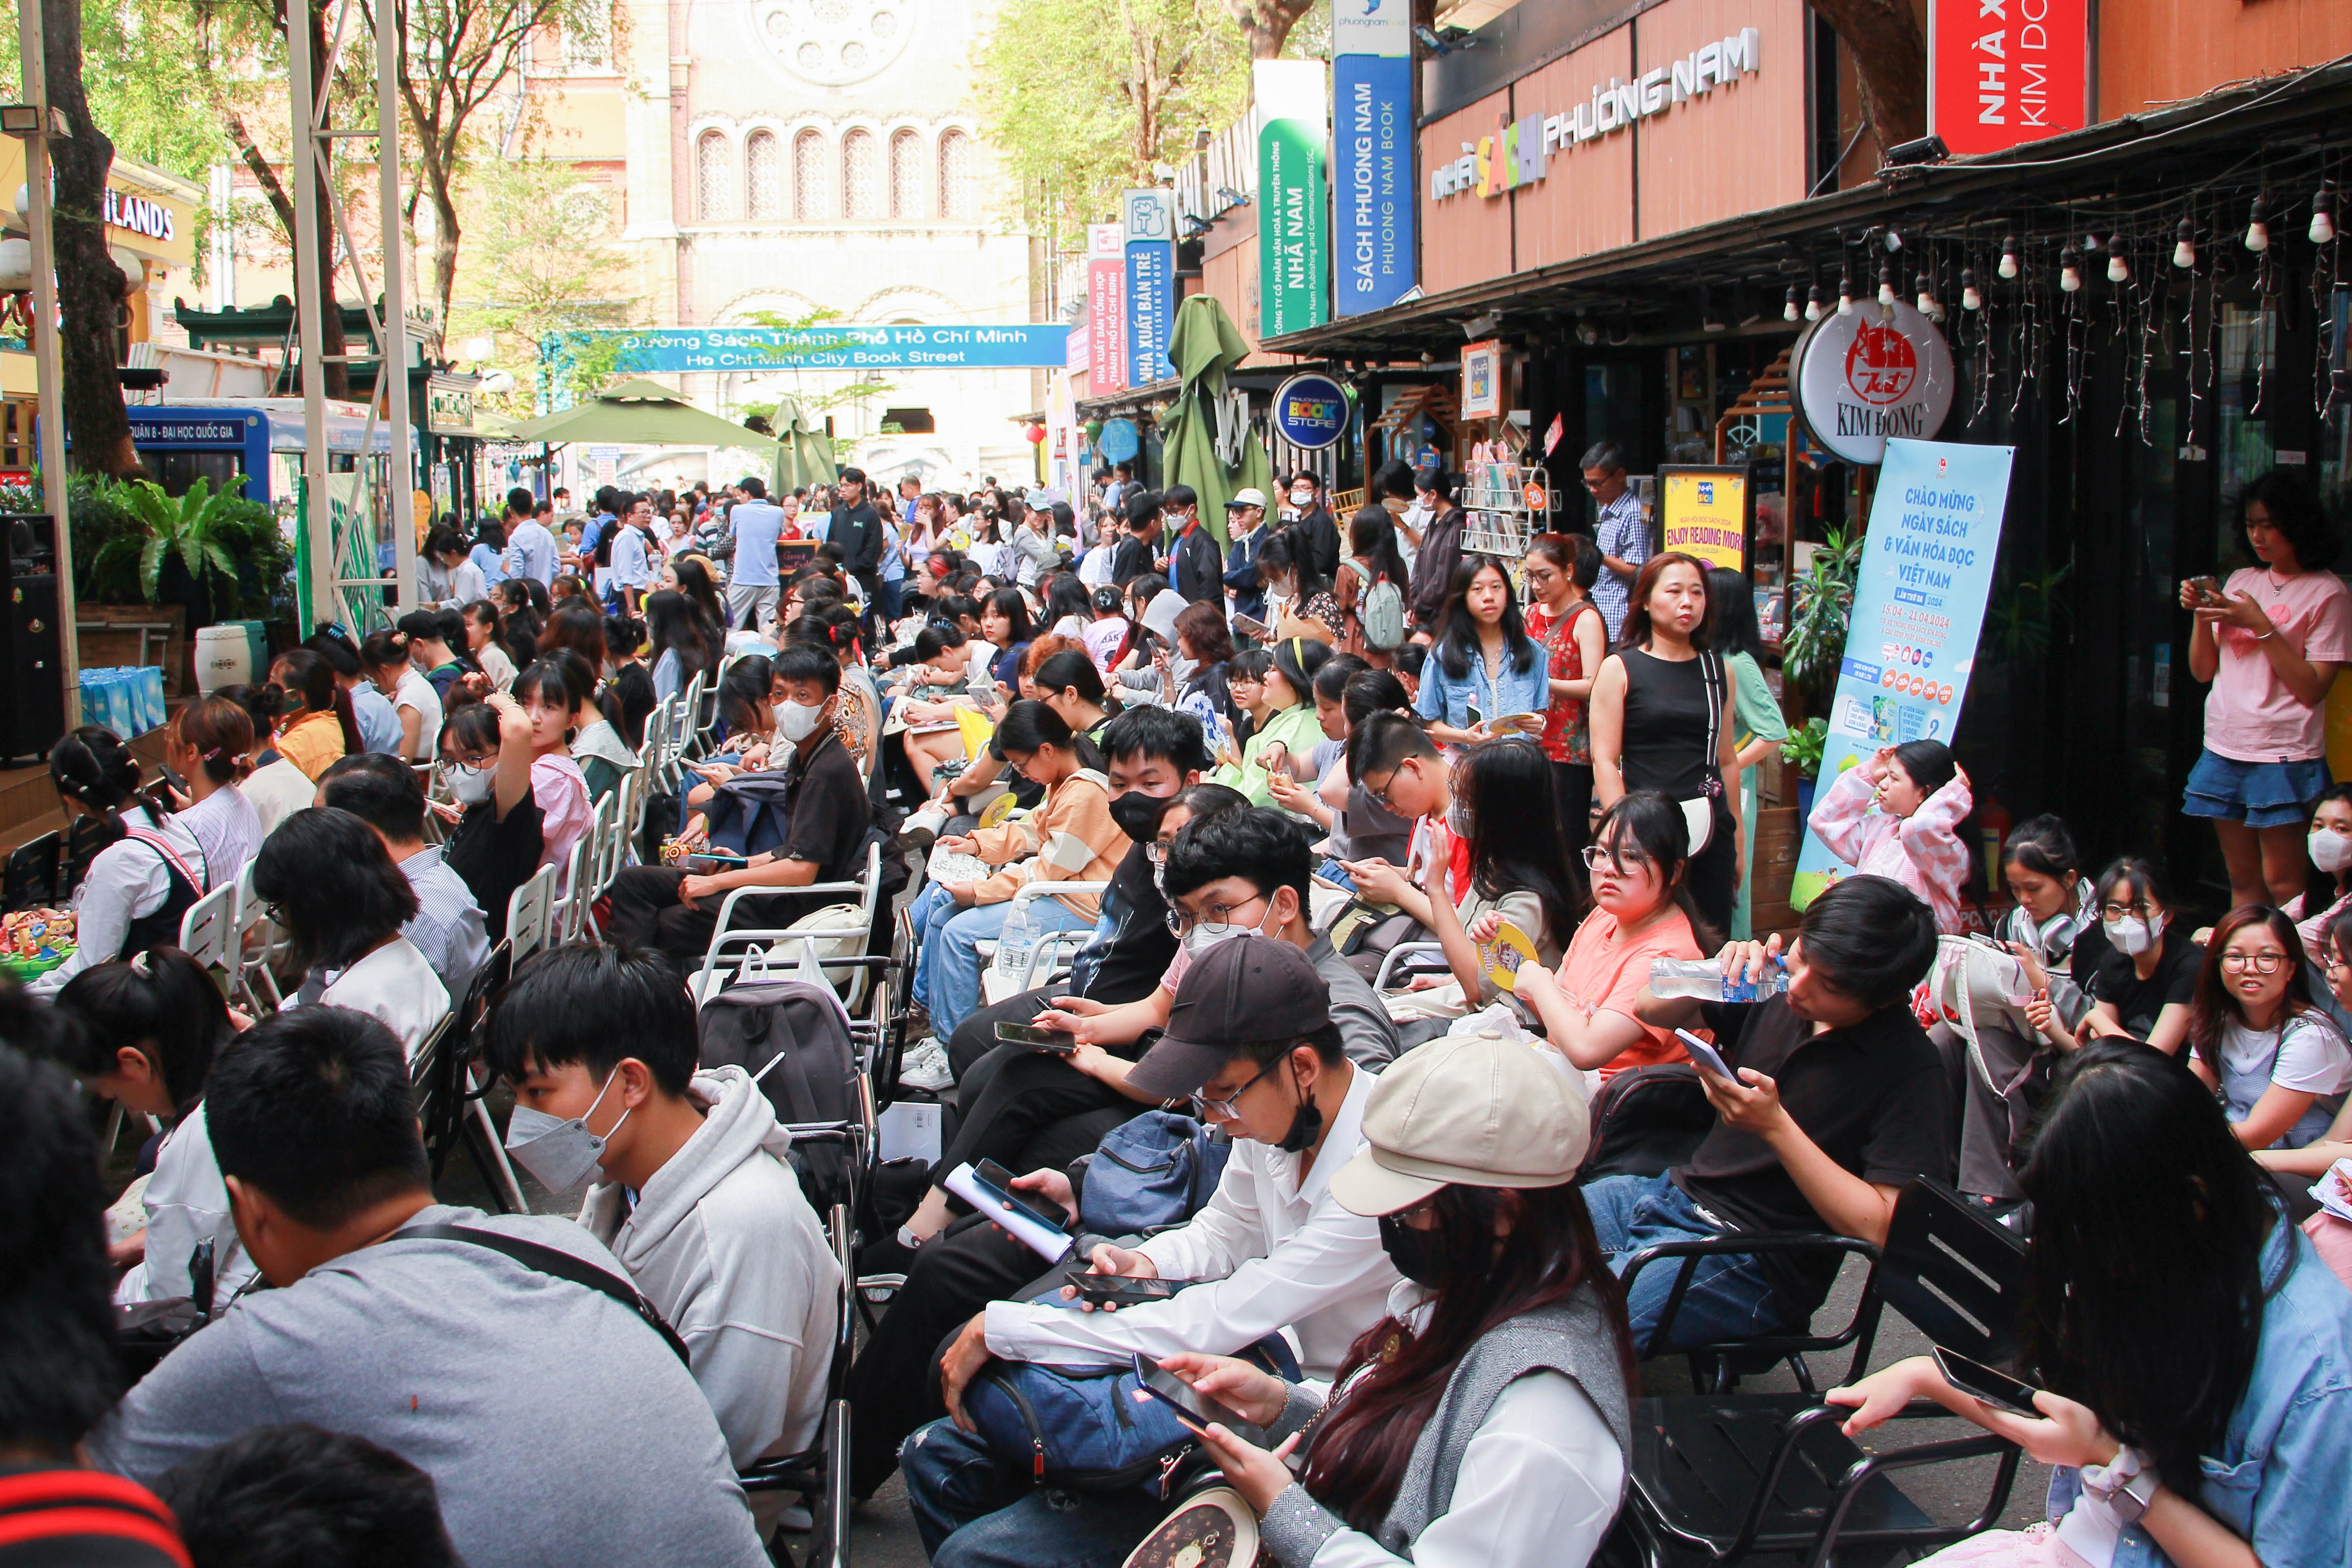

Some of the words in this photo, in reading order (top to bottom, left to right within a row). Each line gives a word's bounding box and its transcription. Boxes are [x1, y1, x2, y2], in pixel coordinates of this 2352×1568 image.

[1971, 29, 2005, 125] NHÀ
[1354, 83, 1371, 132] NAM
[2020, 63, 2046, 126] KIM
[1381, 102, 1393, 149] BOOK
[1431, 142, 1478, 200] NHÀ
[1476, 113, 1545, 198] SÁCH
[1543, 67, 1671, 155] PHƯƠNG
[1671, 27, 1759, 103] NAM
[1271, 141, 1280, 172] THÔNG
[1354, 137, 1373, 226] PHƯƠNG
[1381, 156, 1393, 194] NAM
[1271, 174, 1280, 207] TRUYỀN
[1287, 188, 1303, 237] NAM
[1273, 238, 1281, 254] VĂN
[1381, 202, 1394, 274] PHUONG
[1131, 252, 1151, 279] TRẺ
[1153, 251, 1162, 285] HOUSE
[1273, 258, 1282, 282] PHẦN
[1284, 242, 1304, 288] NHÃ
[1308, 249, 1317, 289] Publishing
[1353, 232, 1374, 292] SÁCH
[1096, 271, 1106, 290] HỢP
[1109, 273, 1117, 296] MINH
[1093, 292, 1105, 315] TỔNG
[1107, 298, 1117, 313] CHÍ
[1133, 281, 1153, 311] BẢN
[1276, 298, 1282, 308] TY
[1094, 319, 1105, 337] BẢN
[1106, 315, 1117, 329] HỒ
[1133, 314, 1153, 349] XUẤT
[1154, 291, 1163, 357] PUBLISHING
[1274, 310, 1282, 335] CÔNG
[707, 333, 763, 347] Sách
[846, 329, 889, 345] Phố
[895, 328, 926, 344] Hồ
[933, 330, 970, 343] Chí
[976, 330, 1027, 343] Minh
[1106, 330, 1118, 350] PHỐ
[687, 354, 714, 366] Ho
[720, 354, 752, 365] Chi
[811, 352, 847, 365] City
[853, 351, 902, 363] Book
[909, 351, 965, 362] Street
[1094, 340, 1106, 363] XUẤT
[1095, 364, 1106, 384] NHÀ
[1107, 352, 1118, 383] THÀNH
[1136, 352, 1154, 382] NHÀ
[1288, 402, 1337, 420] BOOK
[1288, 417, 1336, 428] STORE
[1836, 402, 1871, 436] KIM
[163, 426, 176, 440] ĐẠI
[178, 426, 193, 440] HỌC
[196, 421, 218, 439] QUỐC
[220, 426, 233, 438] GIA
[1905, 485, 1937, 507] CHÀO
[1939, 489, 1974, 512] MỪNG
[1667, 527, 1688, 546] ENJOY
[1690, 527, 1721, 546] READING
[1901, 511, 1934, 533] NGÀY
[1935, 514, 1968, 538] SÁCH
[1884, 536, 1892, 551] &
[1895, 534, 1920, 557] VĂN
[1922, 540, 1945, 561] HÓA
[1947, 547, 1974, 569] ĐỌC
[1899, 562, 1925, 586] VIỆT
[1925, 570, 1951, 589] NAM
[1927, 596, 1943, 607] 2024
[1882, 603, 1902, 617] 15.04
[1908, 609, 1950, 628] 21.04.2024
